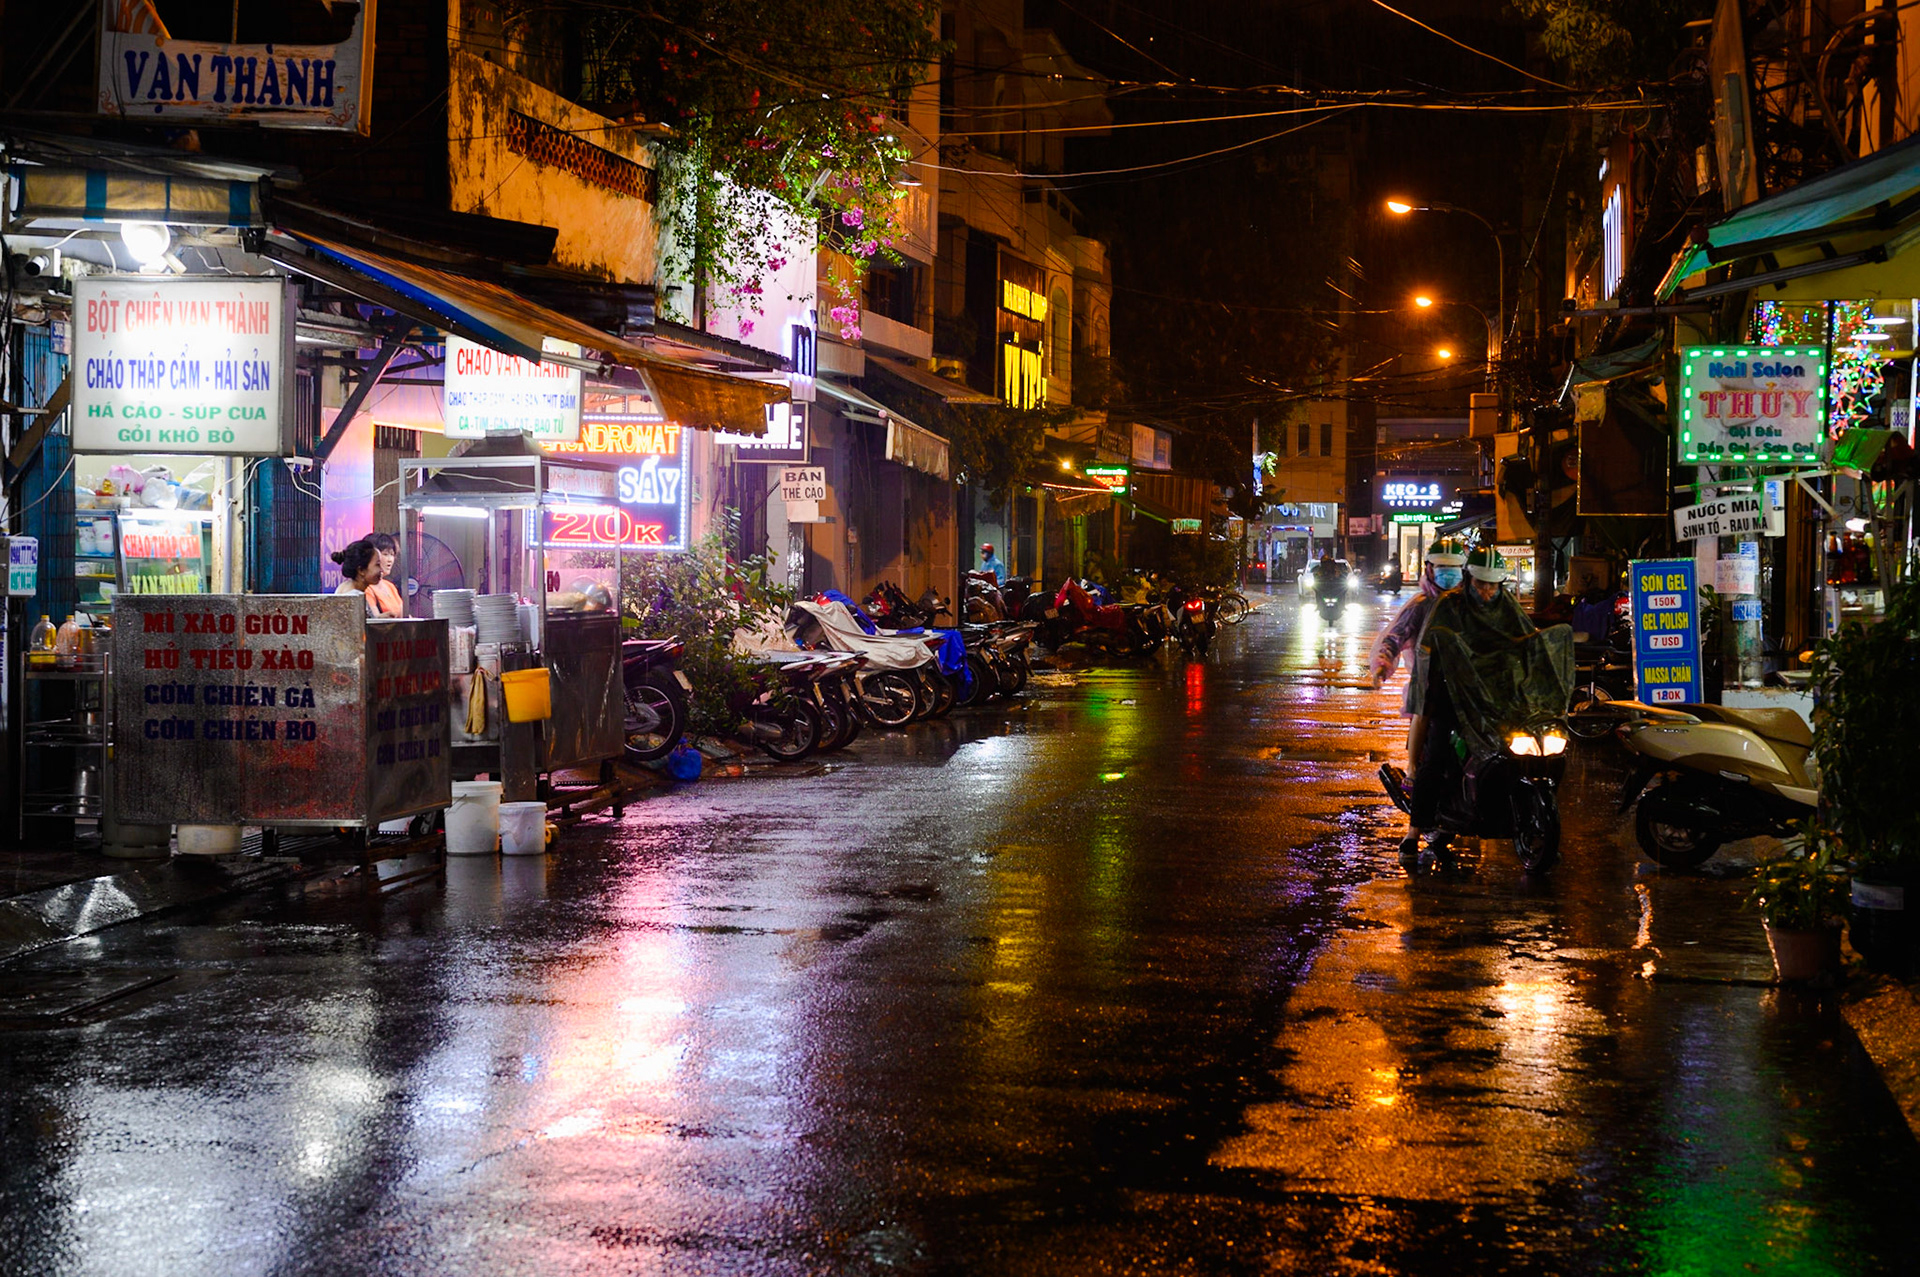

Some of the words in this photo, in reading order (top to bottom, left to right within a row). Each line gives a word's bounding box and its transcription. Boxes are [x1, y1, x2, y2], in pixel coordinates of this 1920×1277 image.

[124, 51, 202, 114] VẠN
[210, 43, 336, 107] THÀNH
[87, 290, 120, 340] BỘT
[125, 291, 173, 332] CHIÊN
[215, 291, 270, 335] THÀNH
[86, 350, 124, 389] CHÁO
[170, 343, 200, 390] CẨM
[215, 348, 238, 390] HẢI
[242, 348, 270, 390] SẢN
[1708, 361, 1747, 378] Nail
[1752, 362, 1805, 378] Salon
[88, 401, 114, 418] HÁ
[228, 407, 267, 420] CUA
[118, 424, 151, 442] GỎI
[159, 426, 199, 443] KHÔ
[208, 427, 235, 443] BÒ
[785, 469, 821, 482] BÁN
[805, 484, 823, 498] CÀO
[1688, 501, 1726, 520] NƯỚC
[1732, 497, 1760, 513] MÍA
[1683, 523, 1705, 538] SINH
[1707, 516, 1719, 533] TỐ
[1730, 518, 1749, 532] RAU
[1641, 573, 1663, 592] SƠN
[1666, 574, 1687, 591] GEL
[1653, 596, 1676, 607] 150K
[143, 608, 174, 633] MÌ
[183, 608, 235, 634] XÀO
[245, 608, 308, 635] GIÒN
[1642, 613, 1658, 630] GEL
[1660, 612, 1689, 629] POLISH
[1653, 638, 1658, 646] 7
[1662, 636, 1679, 646] USD
[144, 642, 179, 669] HỦ
[190, 642, 253, 669] TIẾU
[261, 645, 314, 670] XÀO
[1644, 667, 1670, 684] MASSA
[144, 680, 195, 705] CƠM
[204, 681, 276, 707] CHIÊN
[285, 682, 316, 708] GÀ
[144, 716, 195, 740] CƠM
[204, 716, 276, 740] CHIÊN
[286, 714, 316, 741] BÒ
